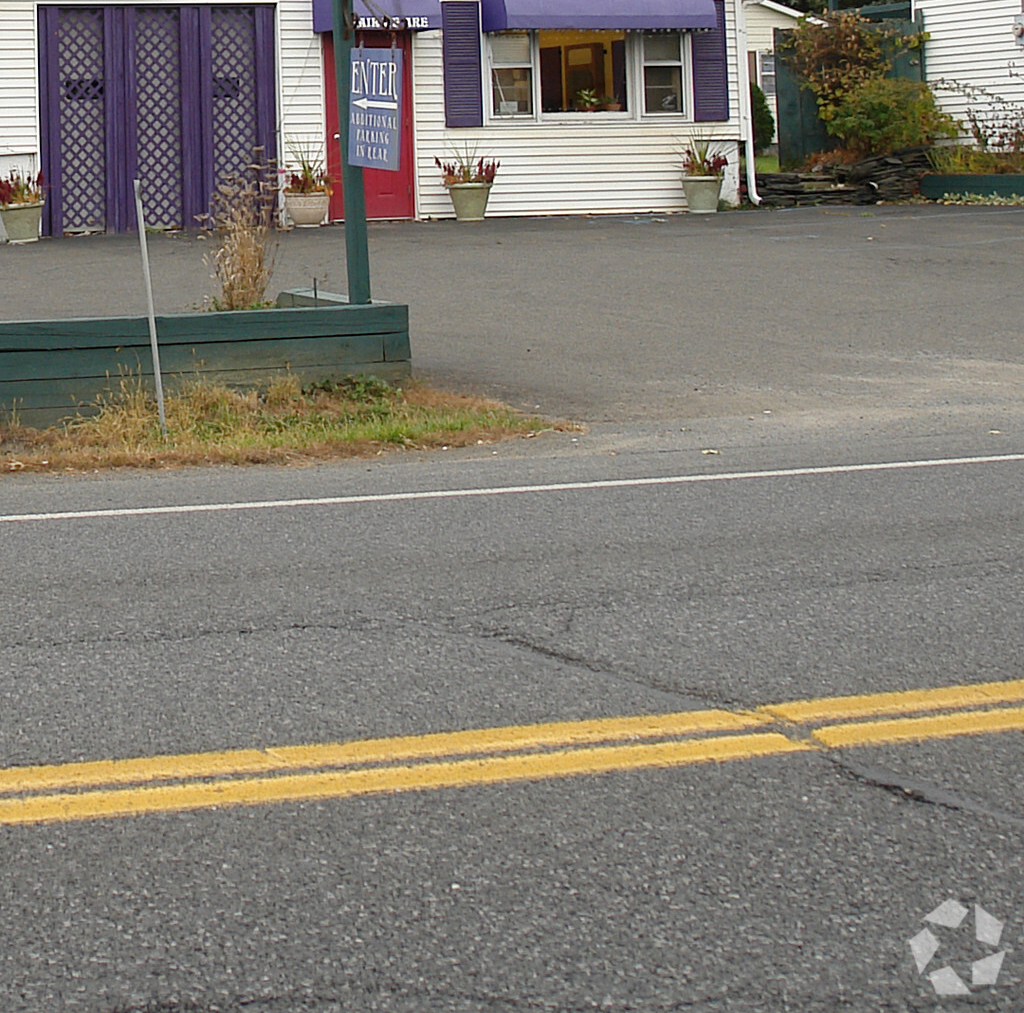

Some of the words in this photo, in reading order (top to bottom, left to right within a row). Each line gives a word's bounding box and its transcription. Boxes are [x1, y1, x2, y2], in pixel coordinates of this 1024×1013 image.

[352, 59, 398, 100] ENTER
[351, 112, 397, 130] ADDITIONAL
[356, 128, 389, 145] PARKING
[356, 144, 365, 157] IN
[367, 146, 388, 162] REAR
